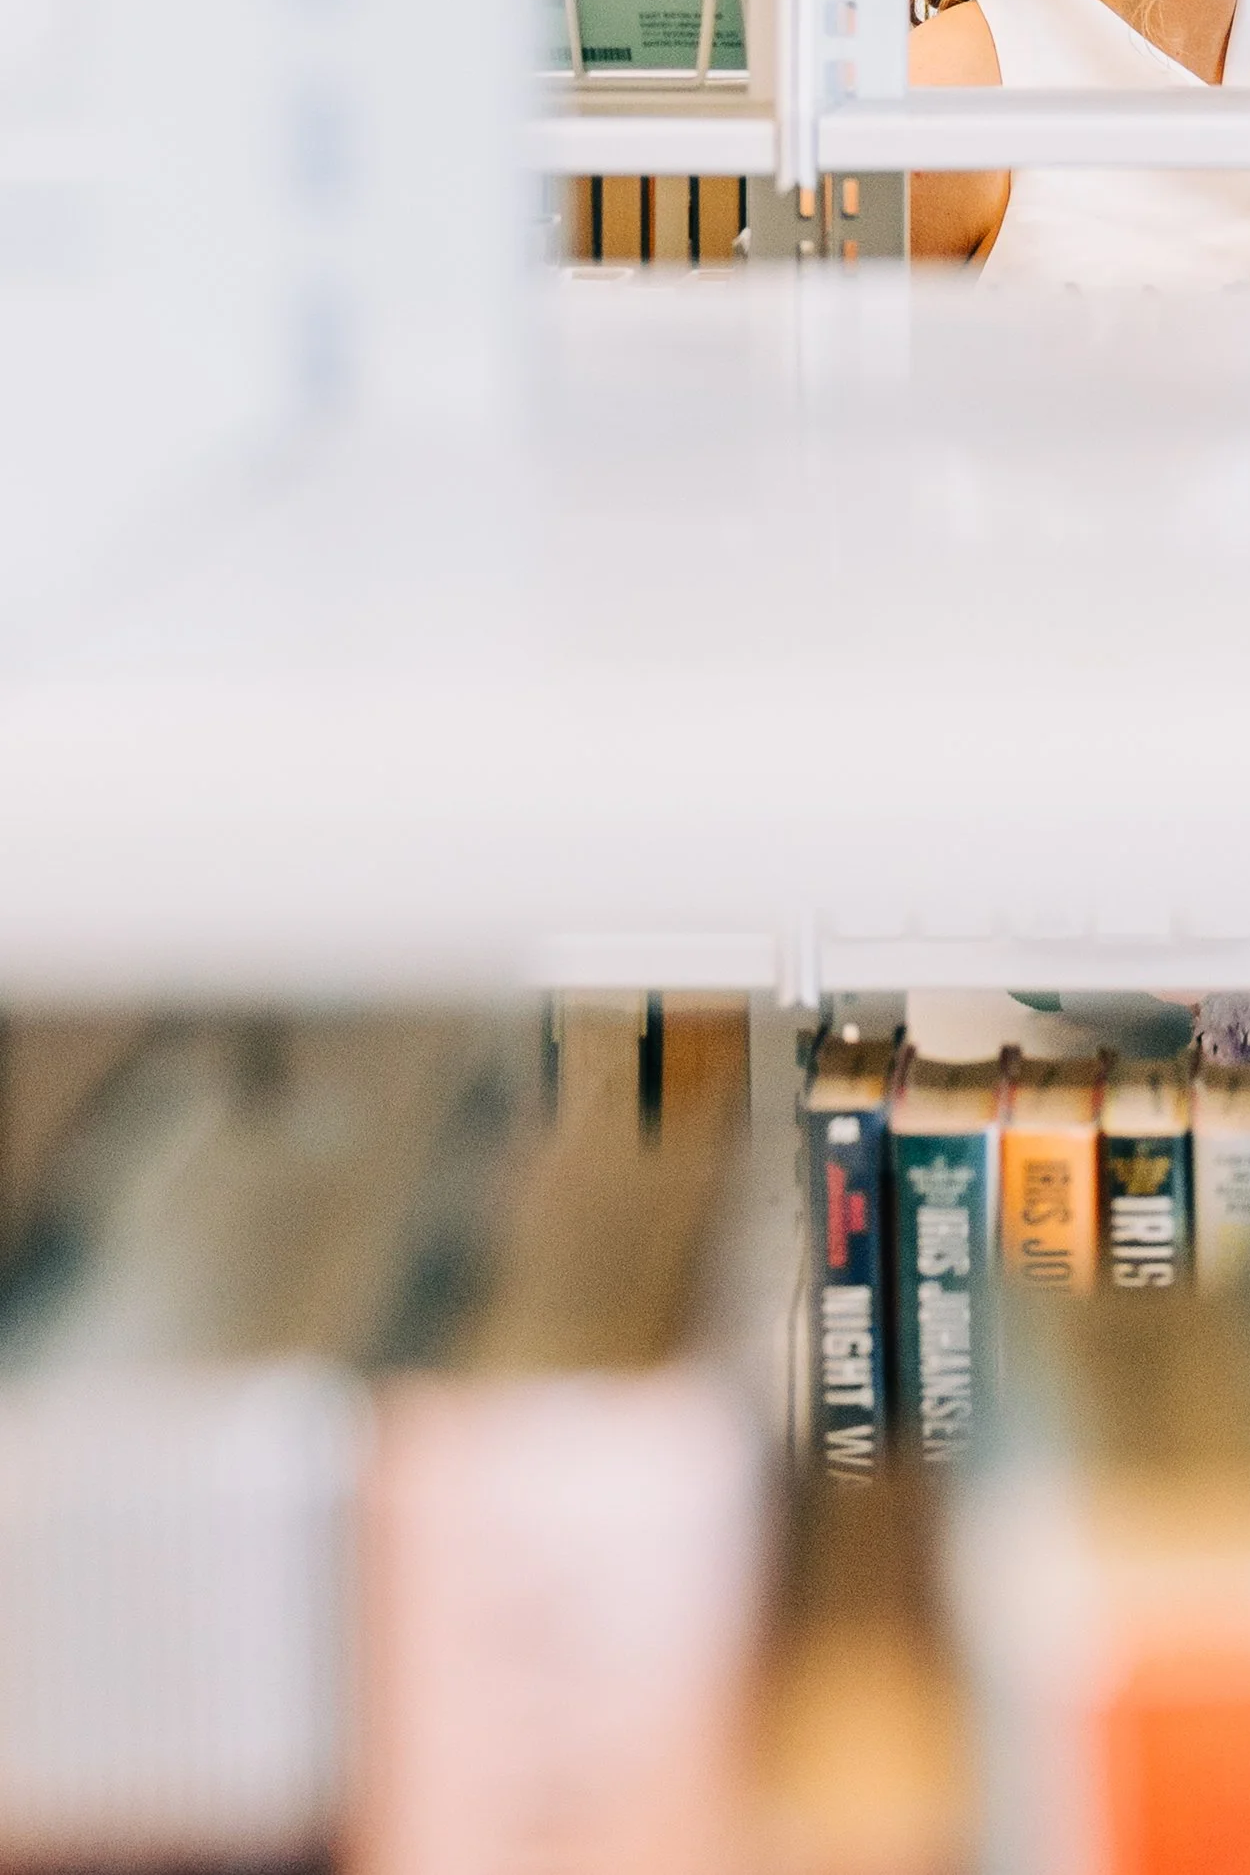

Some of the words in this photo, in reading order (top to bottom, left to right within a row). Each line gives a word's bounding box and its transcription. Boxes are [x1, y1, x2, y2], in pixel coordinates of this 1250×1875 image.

[916, 1204, 971, 1276] IRIS
[1111, 1196, 1175, 1288] IRIS
[822, 1284, 875, 1408] NIGHT
